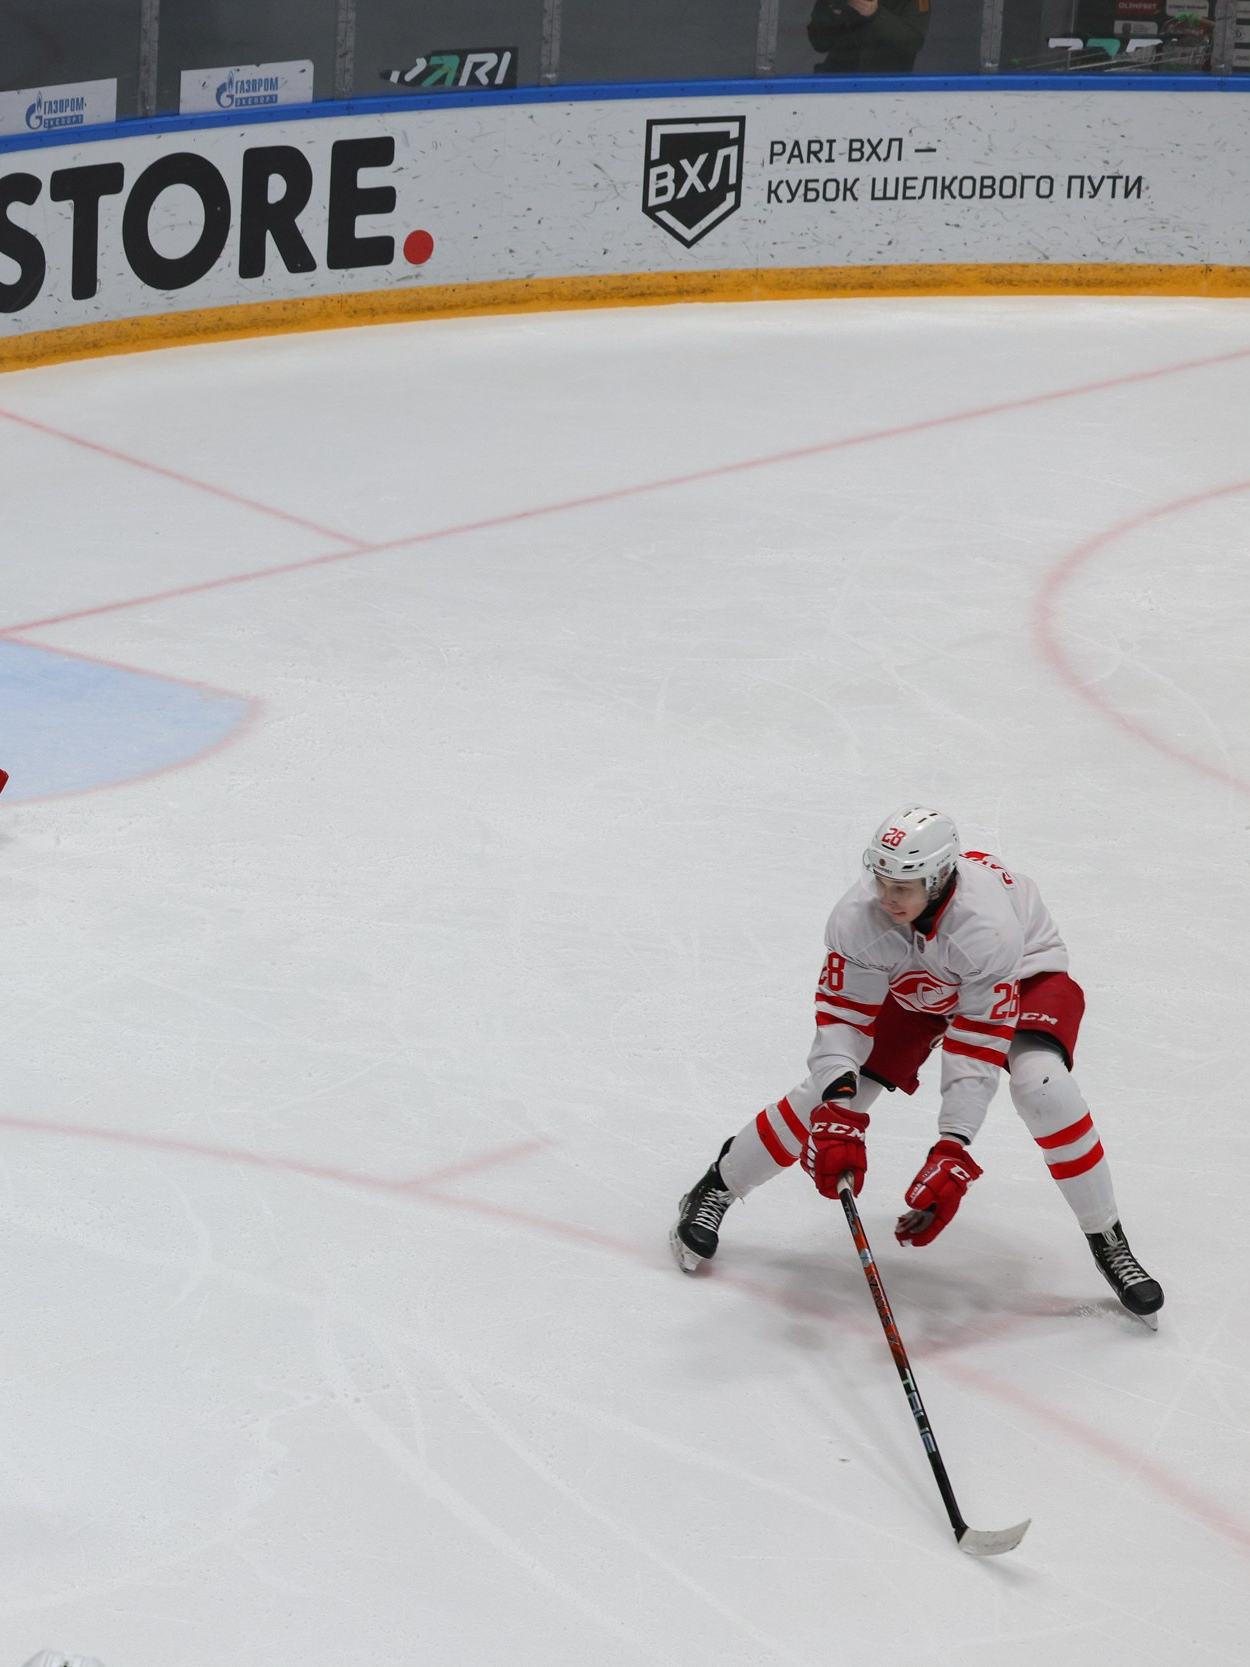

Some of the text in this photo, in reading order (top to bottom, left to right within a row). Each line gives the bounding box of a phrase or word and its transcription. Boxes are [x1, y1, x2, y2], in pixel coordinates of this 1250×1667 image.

[235, 77, 279, 95] ГАЗПРОМ
[44, 97, 84, 114] ГАЗПРОМ
[769, 138, 836, 165] PARI
[848, 138, 904, 163] ВХЛ
[649, 144, 738, 207] ВХЛ
[767, 175, 1143, 204] КУБОК ШЕЛКОВОГО ПУТИ
[881, 827, 907, 847] 28
[811, 1122, 866, 1142] CCM
